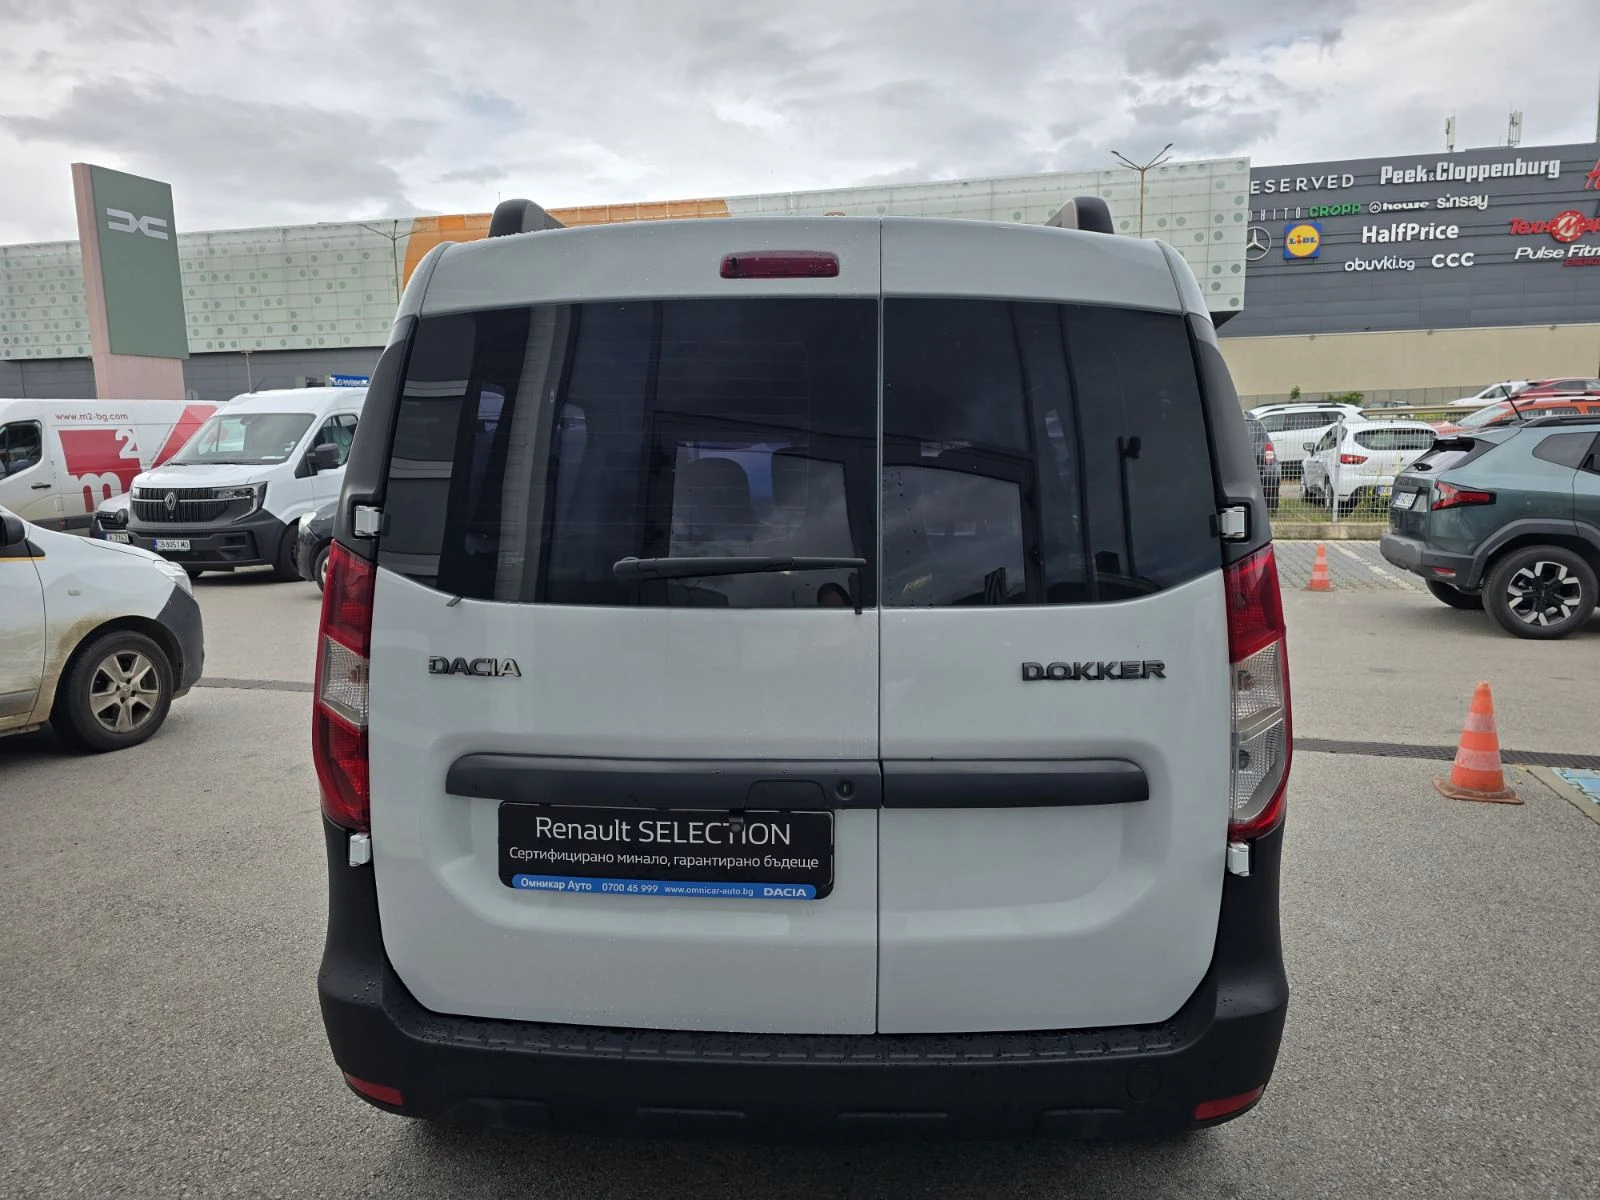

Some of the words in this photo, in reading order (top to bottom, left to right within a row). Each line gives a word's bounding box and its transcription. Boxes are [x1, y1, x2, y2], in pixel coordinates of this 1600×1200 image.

[1383, 201, 1430, 211] house
[1436, 194, 1489, 210] sinsay
[1308, 204, 1361, 218] CROPP
[1361, 223, 1459, 244] HalfPrice
[1431, 252, 1475, 268] CCC
[1514, 246, 1565, 260] Pulse
[55, 412, 129, 421] www.m2-bg.com
[429, 656, 522, 677] DACIA
[1022, 660, 1166, 681] DOKKER
[536, 816, 631, 841] Renault
[509, 847, 614, 864] Сертифицирано
[617, 855, 671, 867] минало,
[674, 856, 760, 868] гарантирано
[764, 855, 819, 869] бъдеще
[520, 877, 566, 890] Омникар
[567, 880, 592, 892] Ауто
[601, 883, 625, 892] 0700
[627, 884, 639, 892] 45
[641, 884, 658, 893] 999
[664, 886, 754, 897] www.omnicar-auto.bg
[763, 887, 807, 897] DACIA
